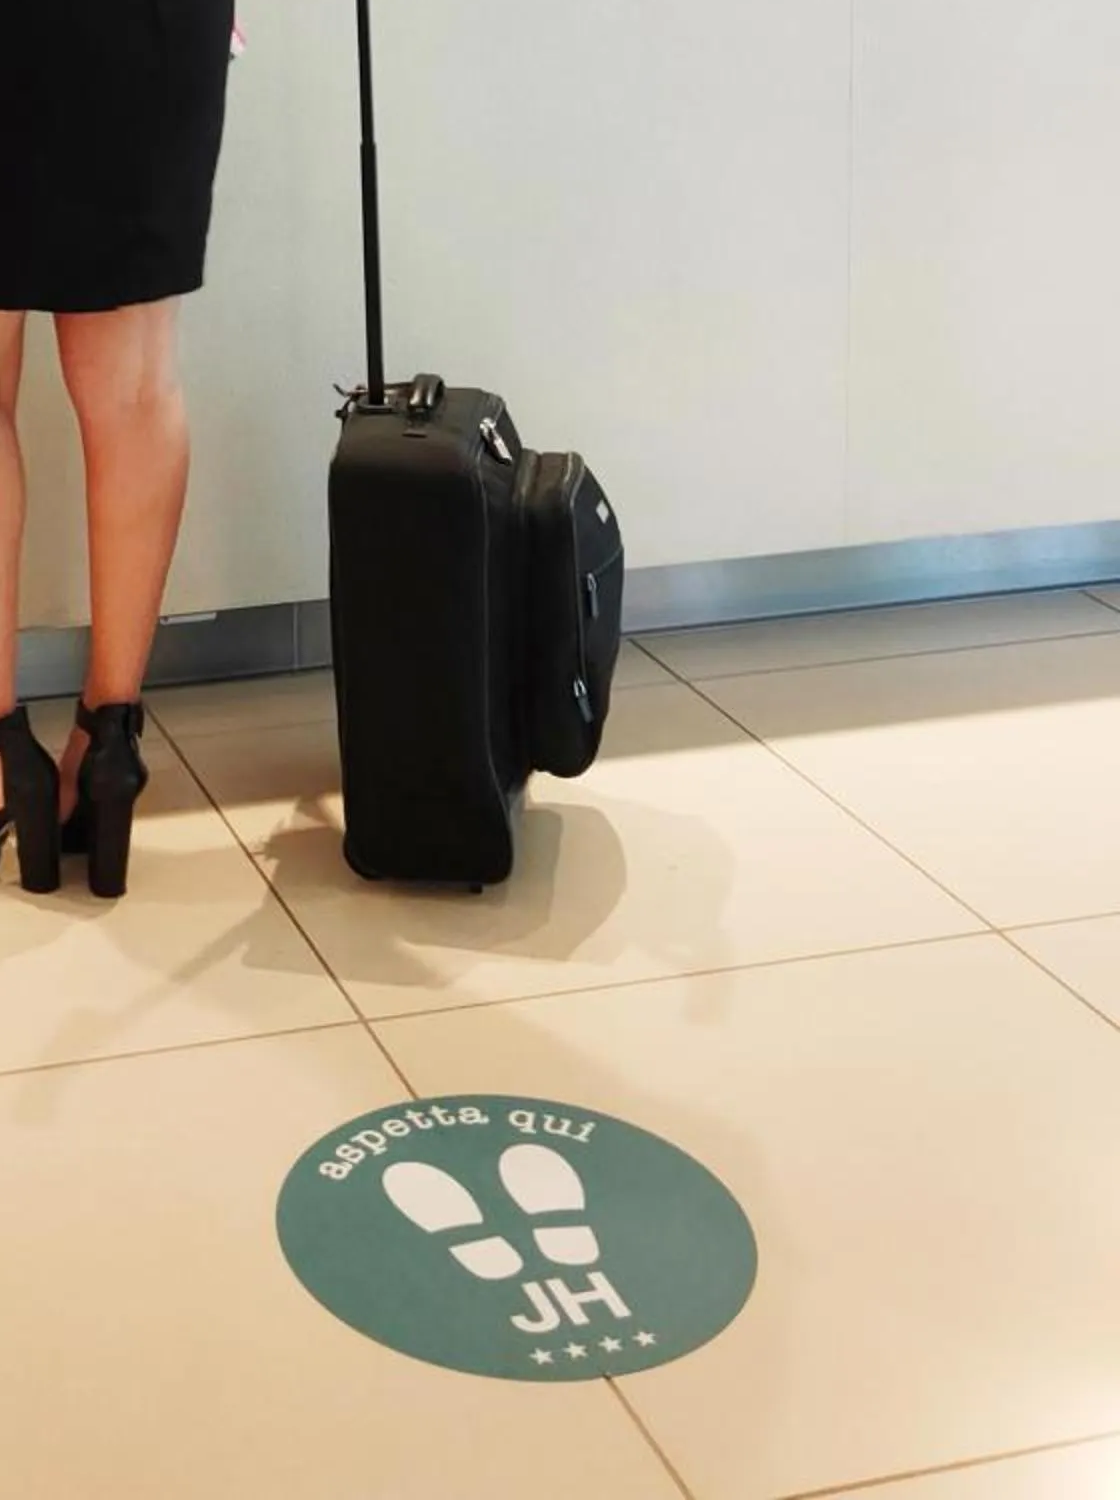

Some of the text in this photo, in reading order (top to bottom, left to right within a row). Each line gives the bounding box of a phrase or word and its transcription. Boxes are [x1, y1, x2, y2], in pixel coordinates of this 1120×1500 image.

[319, 1104, 598, 1181] aspetta qui
[509, 1271, 633, 1334] JH
